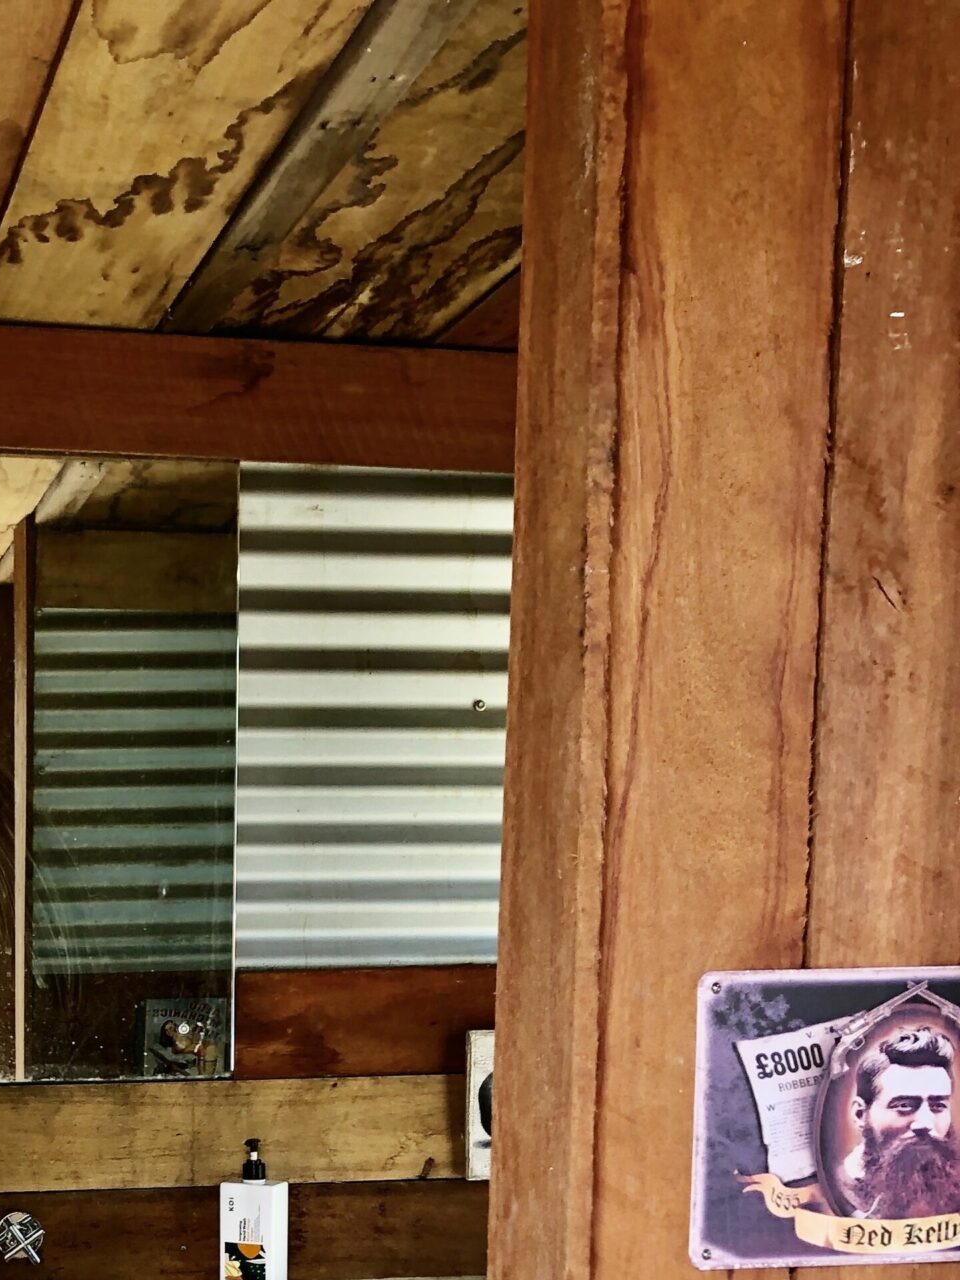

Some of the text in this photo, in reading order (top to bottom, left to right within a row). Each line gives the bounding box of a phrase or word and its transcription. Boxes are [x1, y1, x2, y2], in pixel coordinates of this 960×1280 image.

[755, 1043, 824, 1079] £8000
[771, 1187, 801, 1210] 1855
[839, 1223, 893, 1247] Ned
